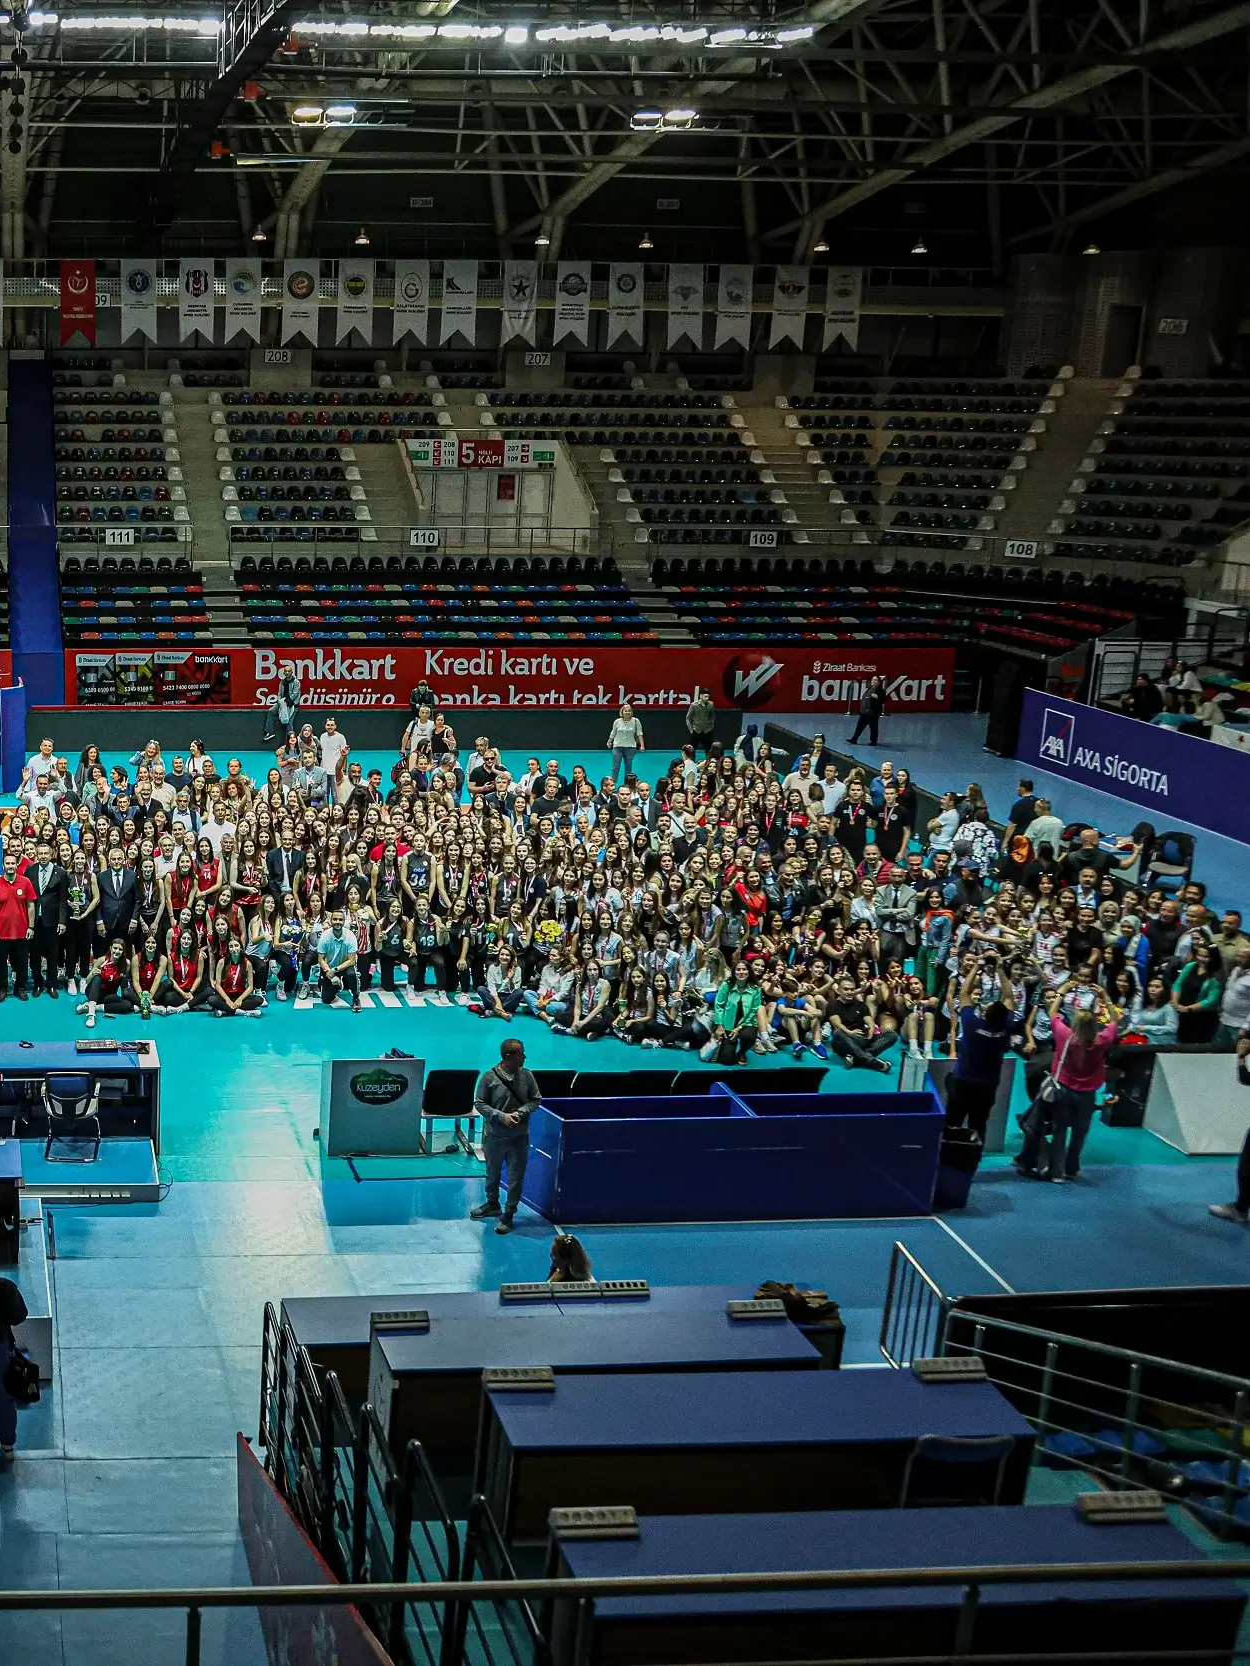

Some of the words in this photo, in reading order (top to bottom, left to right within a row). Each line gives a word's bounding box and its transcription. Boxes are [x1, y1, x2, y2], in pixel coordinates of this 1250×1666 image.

[267, 350, 288, 362] 208
[528, 353, 549, 365] 207
[461, 442, 475, 464] 5
[478, 455, 502, 464] KAPI
[109, 531, 131, 543] 111
[413, 531, 435, 544] 110
[752, 533, 774, 545] 109
[1009, 543, 1034, 555] 108
[254, 648, 396, 681] Bankkart
[425, 649, 494, 676] Kredi
[500, 649, 557, 676] kartı
[563, 657, 595, 676] ve
[822, 662, 846, 672] Ziraat
[846, 662, 877, 672] Bankası
[1073, 746, 1101, 773] AXA
[1103, 754, 1169, 796] SİGORTA
[410, 873, 427, 887] 36
[390, 934, 400, 945] 6
[109, 974, 114, 982] 3
[146, 970, 152, 978] 5
[356, 1082, 401, 1094] Kuzeyden
